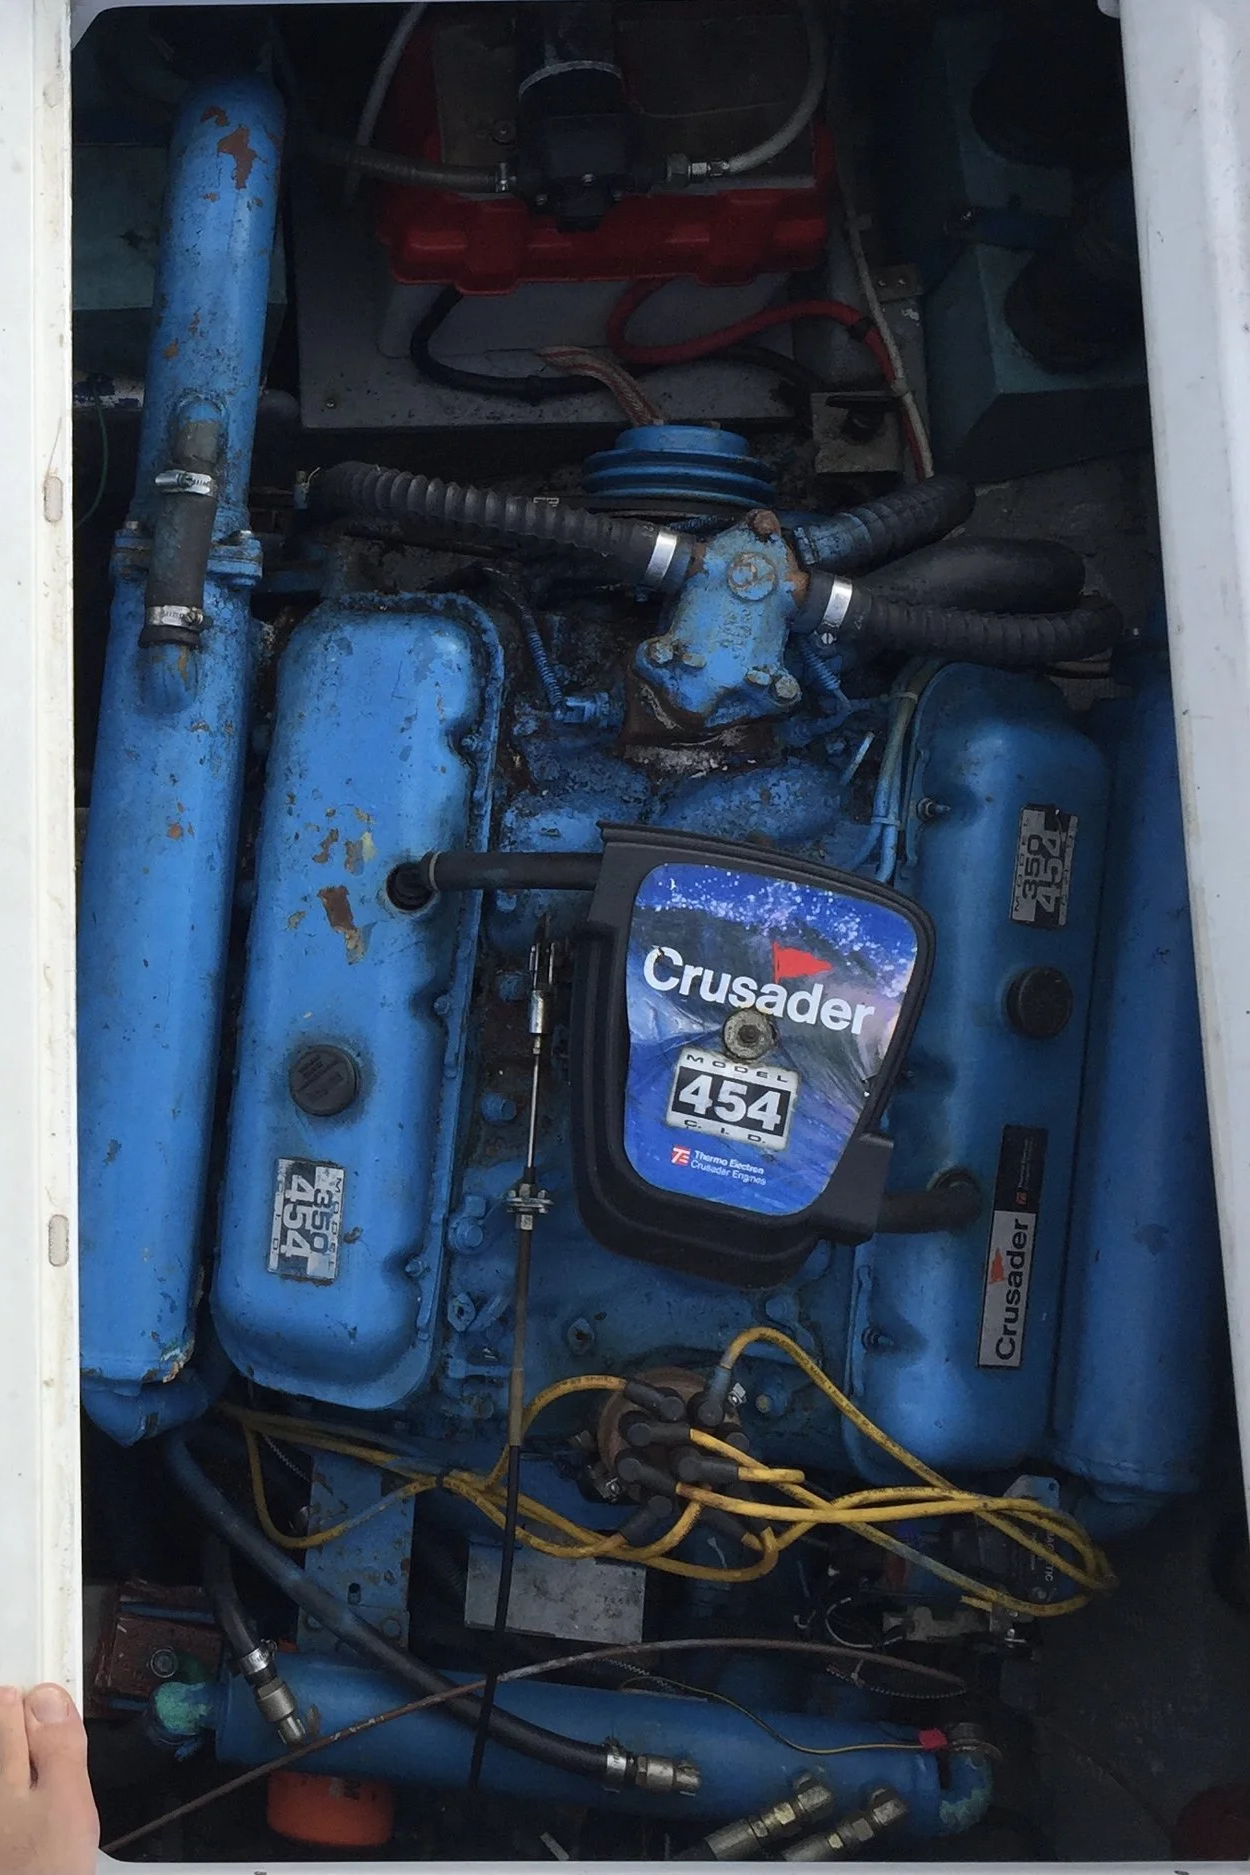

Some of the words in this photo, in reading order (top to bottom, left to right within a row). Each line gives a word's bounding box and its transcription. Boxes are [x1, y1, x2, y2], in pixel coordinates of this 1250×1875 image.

[1021, 834, 1043, 900] 350
[1036, 830, 1067, 913] 454
[642, 945, 875, 1035] Crusader
[686, 1054, 788, 1083] MODEL
[678, 1074, 782, 1131] 454
[690, 1160, 731, 1177] Crusader
[731, 1170, 767, 1185] Engines
[694, 1149, 728, 1167] Thermo
[729, 1159, 764, 1174] Electron
[280, 1174, 315, 1258] 454
[310, 1188, 333, 1254] 350
[329, 1177, 342, 1265] MODEL
[995, 1218, 1029, 1360] Crusader
